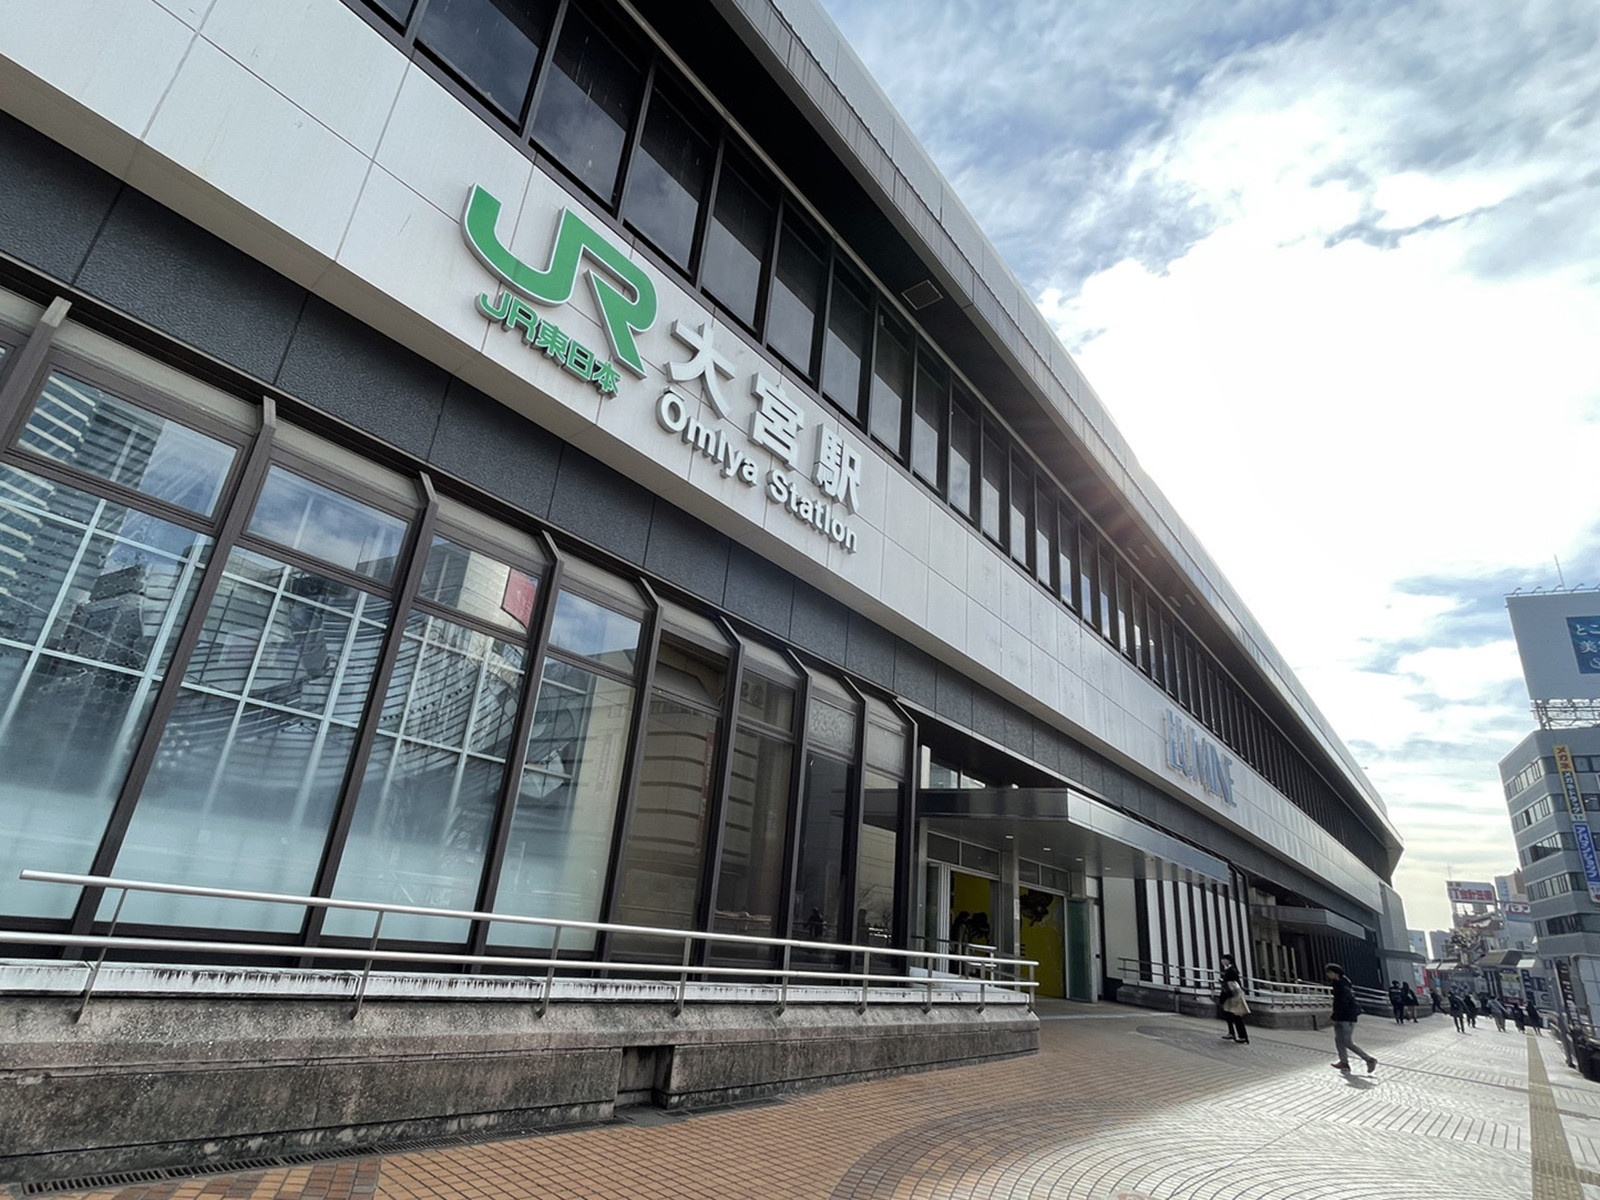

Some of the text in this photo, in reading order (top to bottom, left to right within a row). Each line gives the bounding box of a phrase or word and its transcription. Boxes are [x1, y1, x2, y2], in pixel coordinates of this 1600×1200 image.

[461, 183, 658, 379] JR
[475, 289, 622, 398] JR東日本
[663, 318, 864, 515] 大宮駅
[765, 468, 858, 553] Station
[1580, 640, 1600, 653] 美
